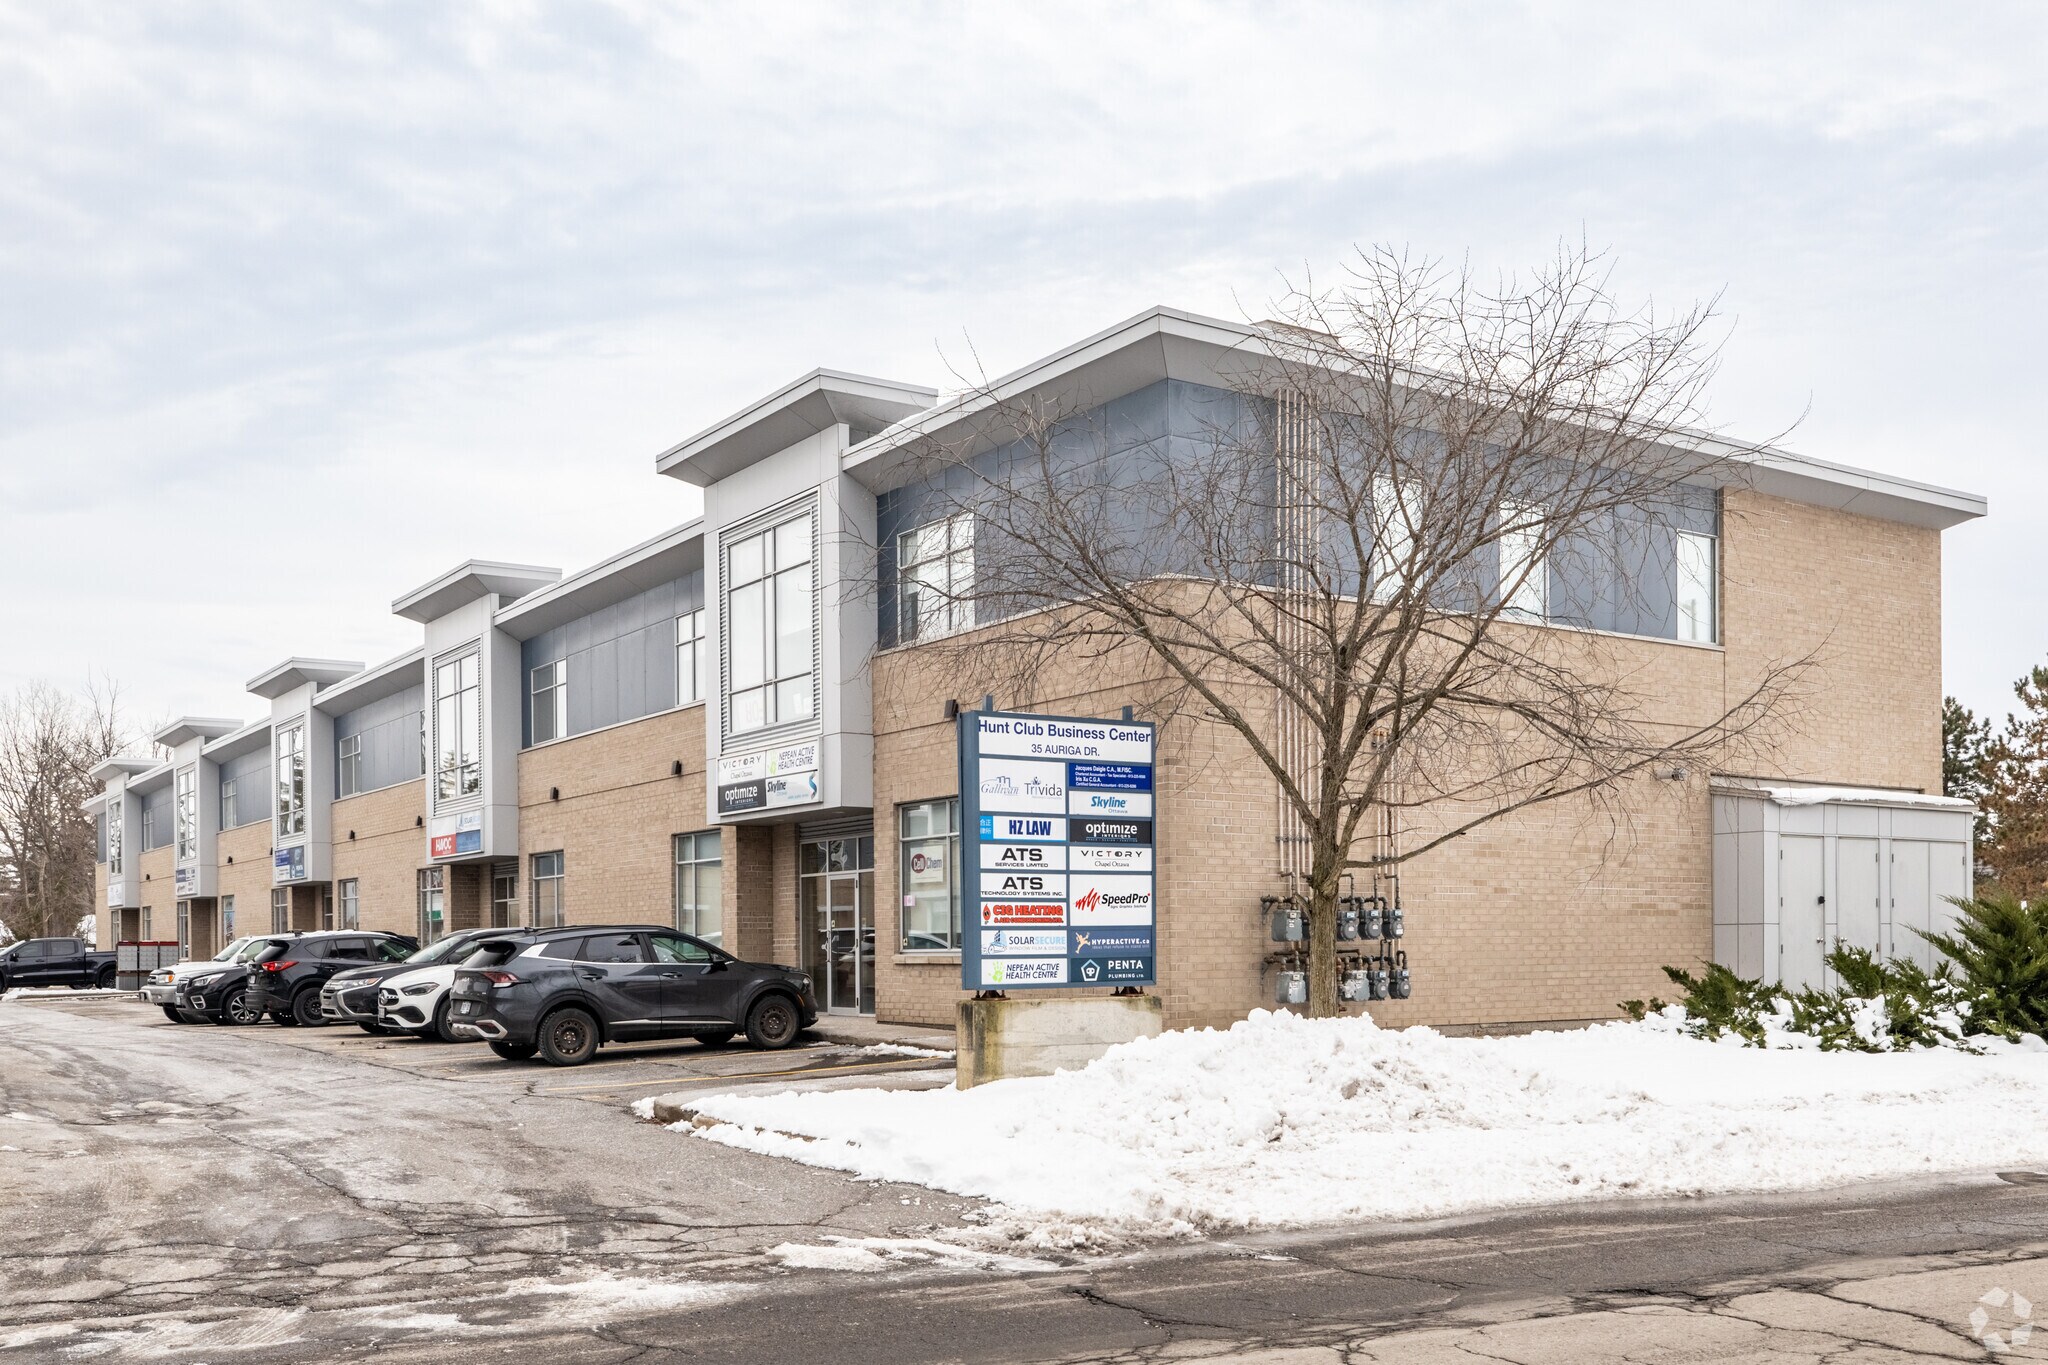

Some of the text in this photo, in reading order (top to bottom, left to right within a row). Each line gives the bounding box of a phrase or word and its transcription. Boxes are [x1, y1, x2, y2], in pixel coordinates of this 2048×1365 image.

[979, 720, 1150, 742] Hunt Club Business Center
[1032, 744, 1100, 756] 35 AURIGA DR.
[722, 756, 762, 769] VICTORY
[767, 780, 786, 793] Skyline
[1024, 782, 1062, 796] Trivida
[725, 786, 758, 804] optimize
[1091, 796, 1126, 808] Skyline
[1009, 820, 1052, 836] HZ LAW
[1086, 822, 1138, 837] optimize
[1002, 848, 1042, 861] ATS
[1002, 877, 1043, 890] ATS
[1102, 893, 1148, 906] SpeedPro
[1015, 905, 1063, 916] HEATING
[1108, 960, 1143, 970] PENTA
